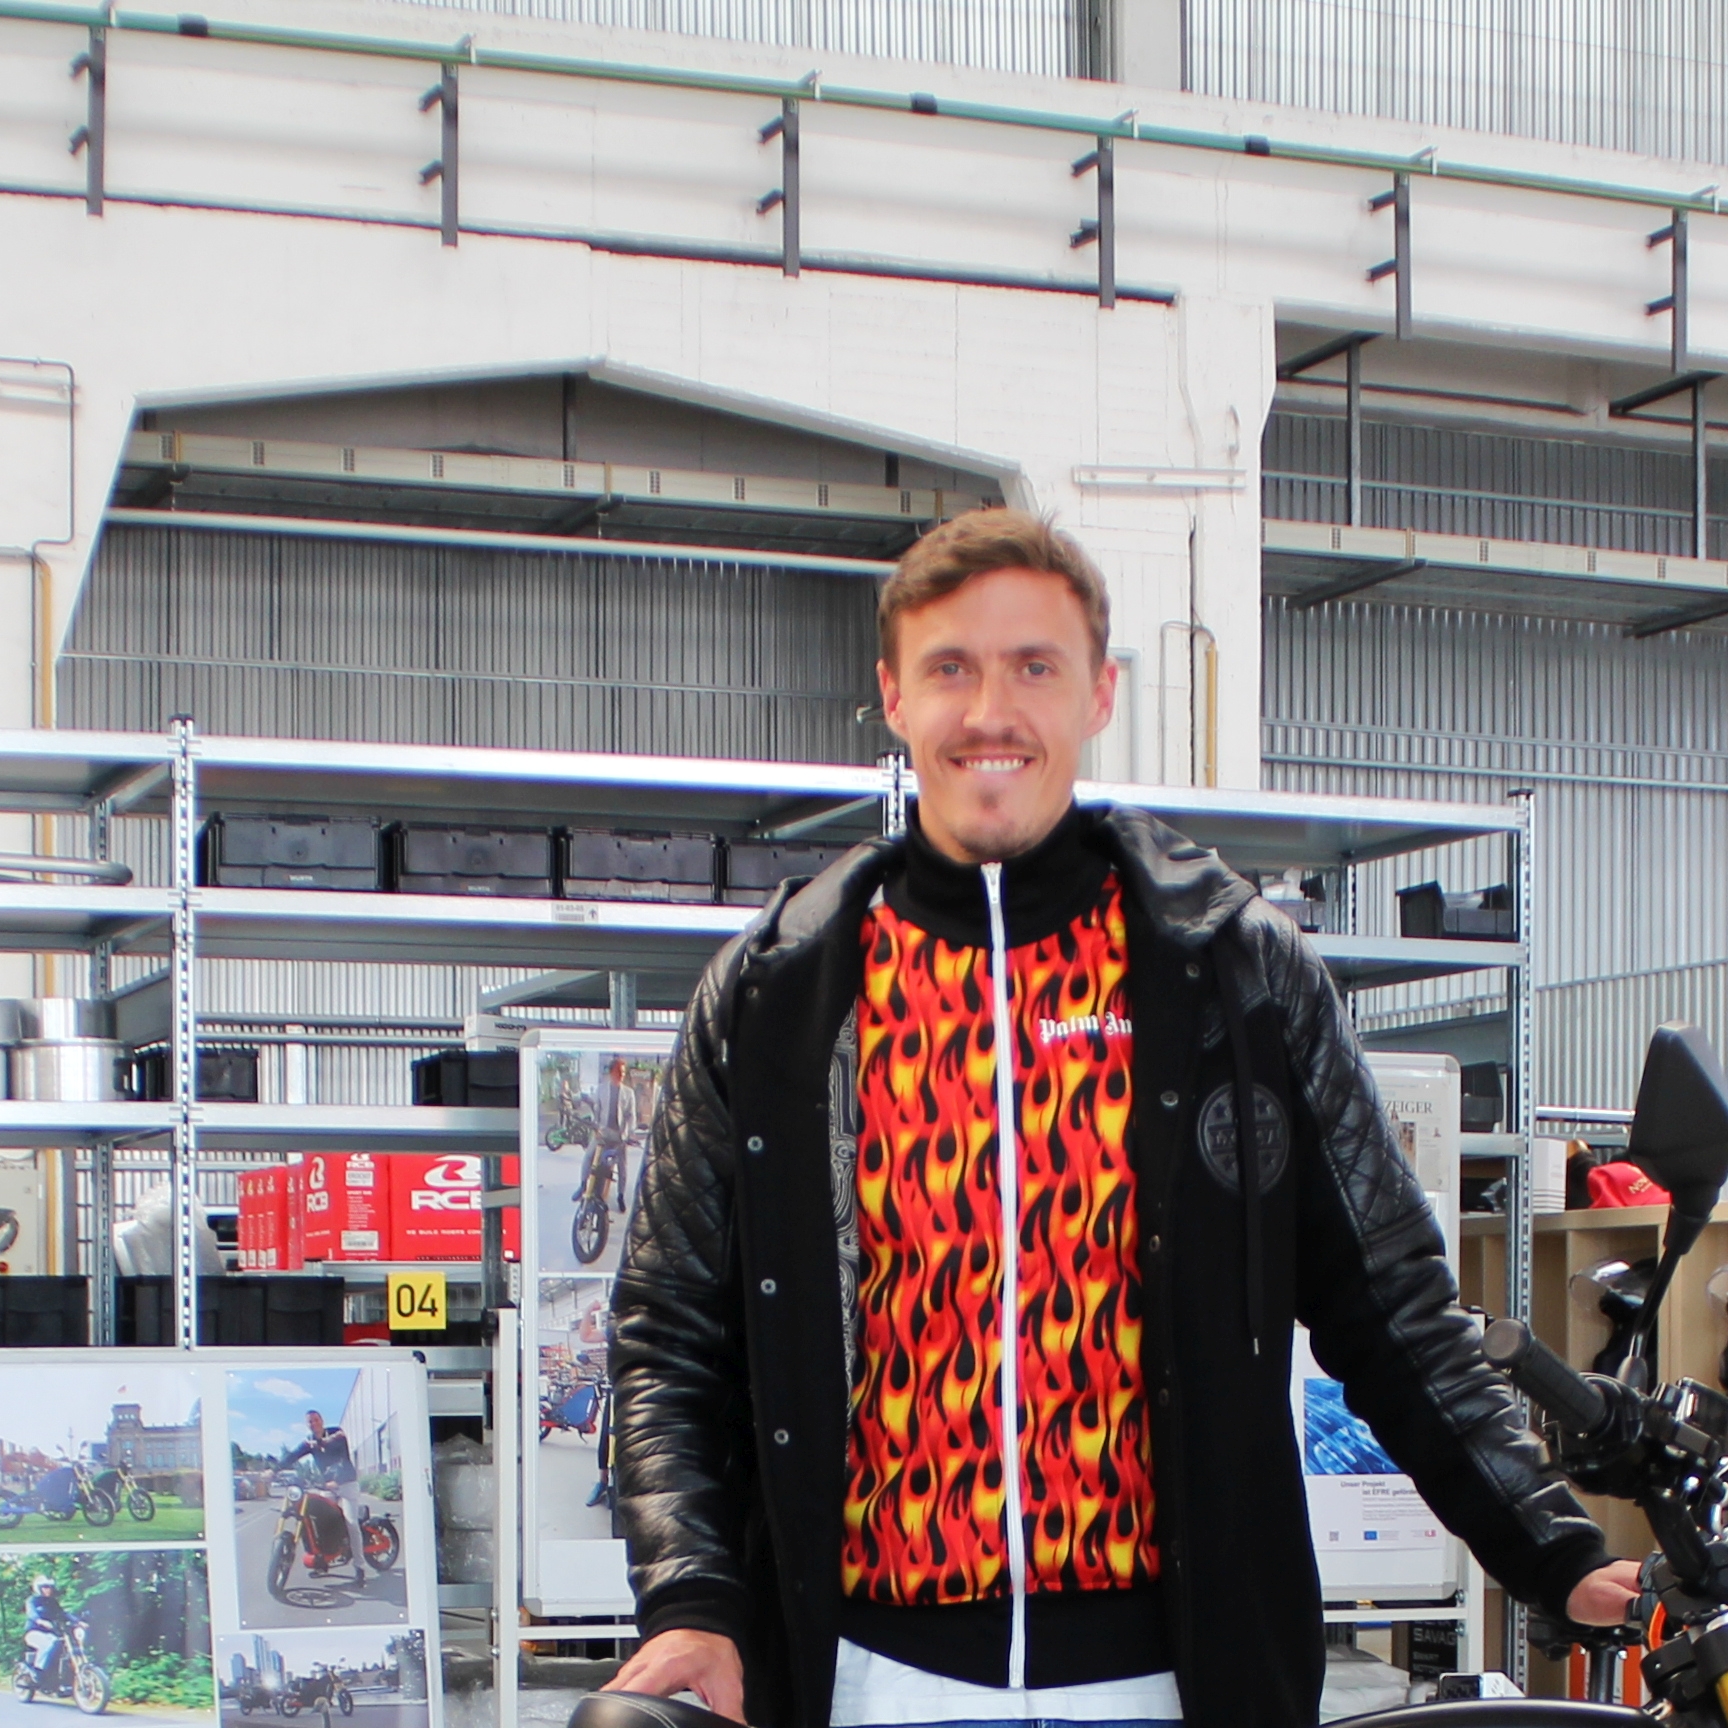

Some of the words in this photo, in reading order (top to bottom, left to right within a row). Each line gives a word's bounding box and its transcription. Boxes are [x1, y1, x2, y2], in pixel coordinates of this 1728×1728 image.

[1039, 1014, 1099, 1043] Palm
[1384, 1101, 1432, 1114] ZEIGER
[306, 1191, 329, 1213] RCB
[396, 1283, 439, 1318] 04
[1413, 1627, 1456, 1645] SAVAG
